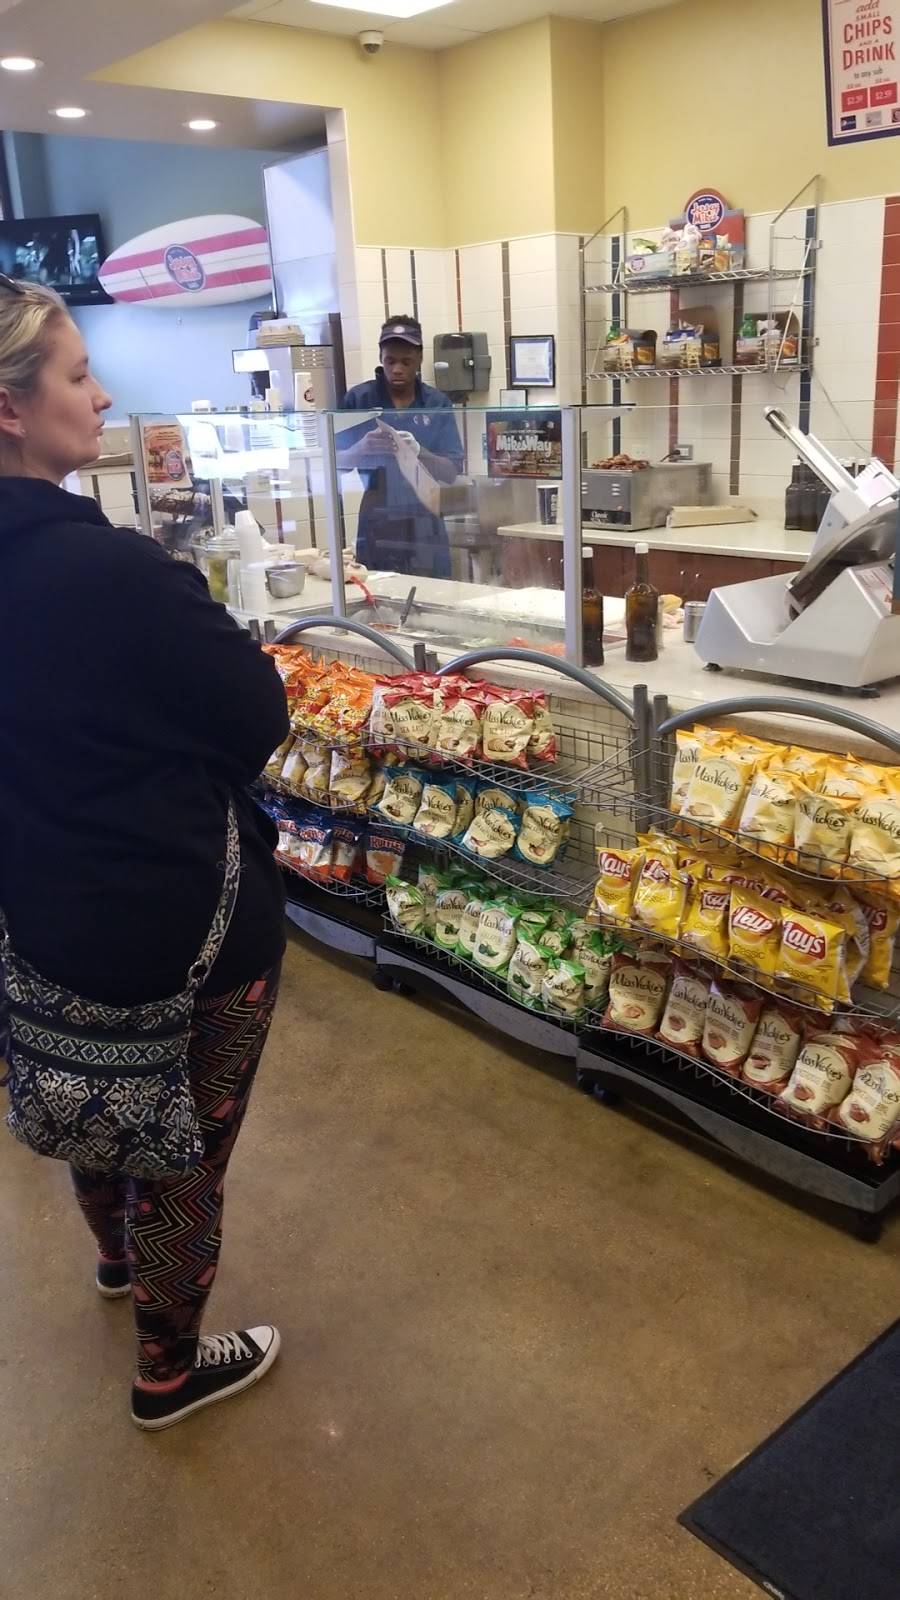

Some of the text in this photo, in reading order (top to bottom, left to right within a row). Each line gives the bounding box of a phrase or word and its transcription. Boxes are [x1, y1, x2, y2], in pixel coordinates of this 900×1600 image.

[856, 11, 880, 20] SMALL
[844, 15, 892, 44] CHIPS
[843, 41, 895, 70] DRINK
[861, 71, 871, 79] any
[526, 434, 552, 458] Way
[370, 835, 405, 853] RUFFLES
